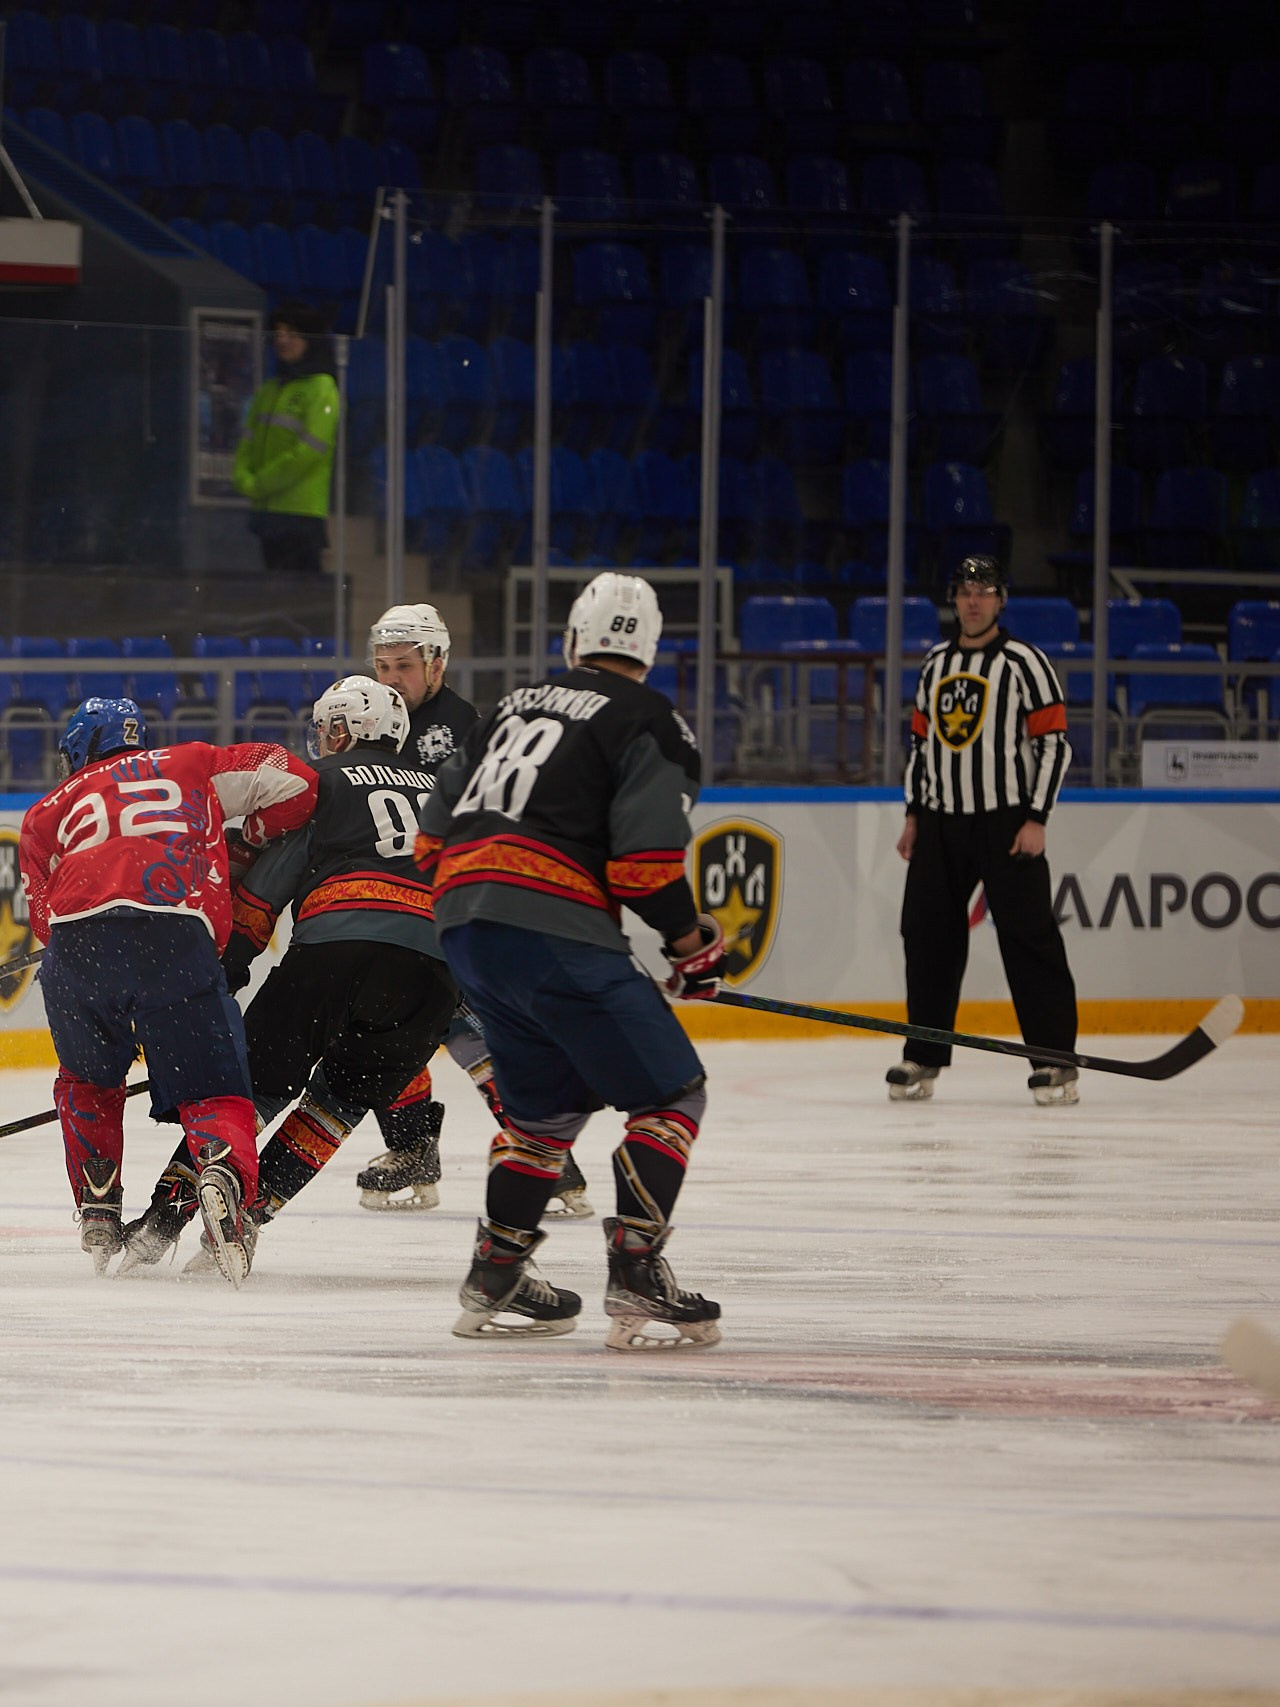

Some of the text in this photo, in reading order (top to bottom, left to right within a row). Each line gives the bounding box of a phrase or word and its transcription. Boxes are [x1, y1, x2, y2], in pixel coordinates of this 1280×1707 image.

[611, 616, 637, 633] 88
[340, 764, 439, 791] БОЛЬШО
[451, 714, 565, 823] 88
[57, 779, 189, 856] 92
